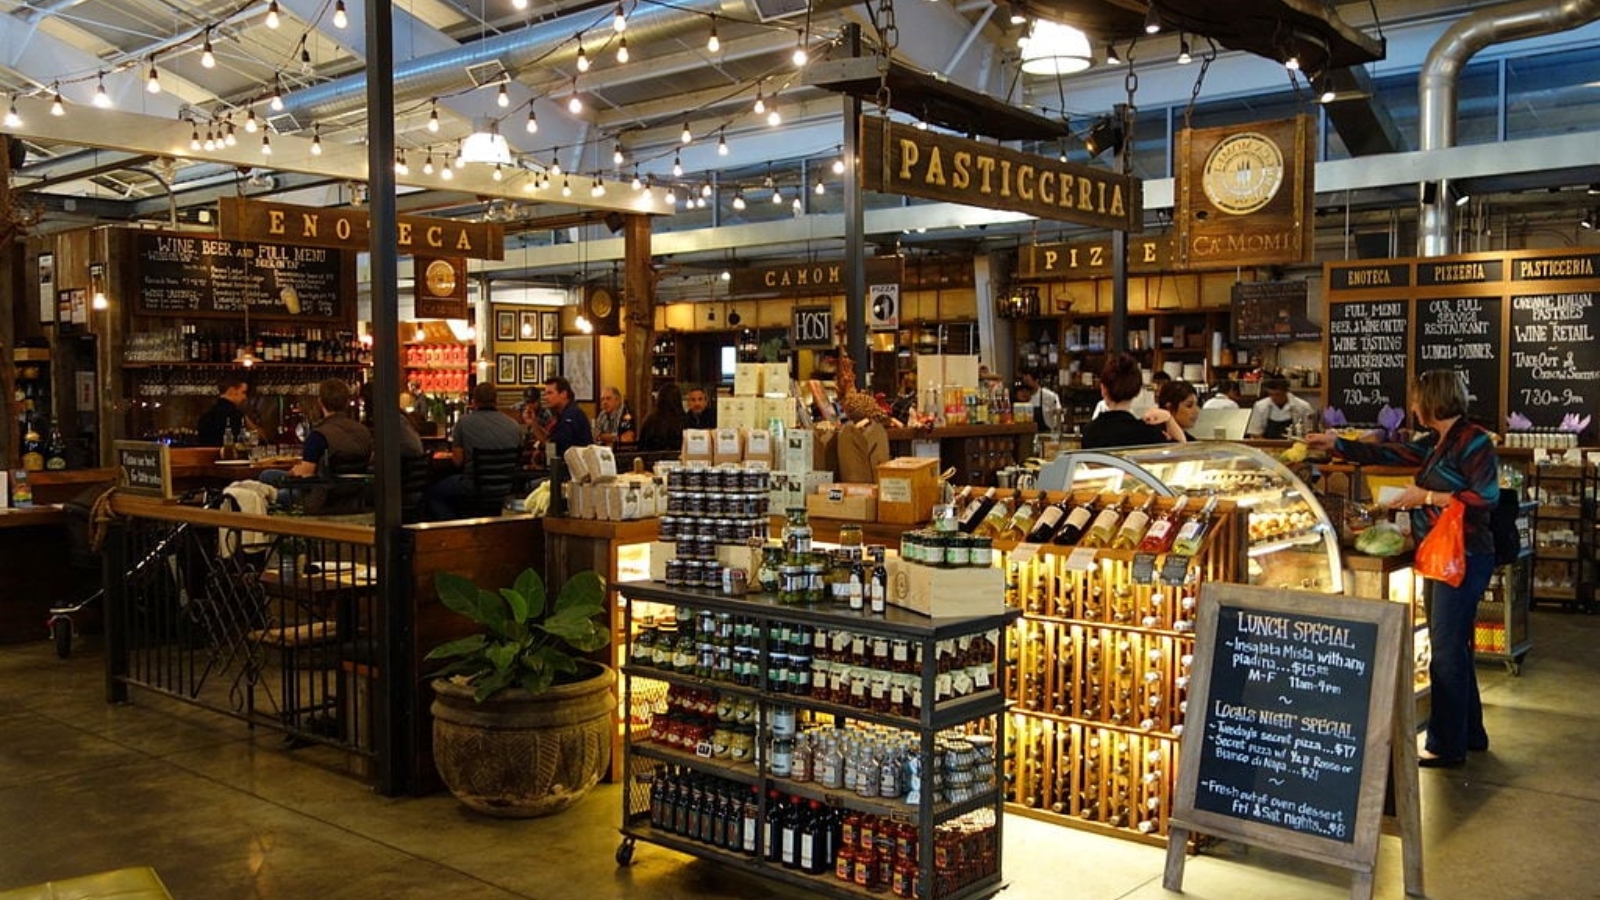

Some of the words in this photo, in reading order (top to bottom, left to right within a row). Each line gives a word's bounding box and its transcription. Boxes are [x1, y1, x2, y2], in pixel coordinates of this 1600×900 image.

[900, 138, 1127, 218] PASTICCERIA
[269, 210, 471, 250] ENOECA
[202, 240, 233, 256] BEER
[258, 245, 289, 260] FULL
[294, 247, 326, 262] MENU
[1045, 243, 1174, 270] PIZE
[765, 266, 840, 287] CAMOM
[1435, 263, 1485, 281] PIZZERIA
[1521, 258, 1593, 278] PASTICCERIA
[1348, 269, 1391, 286] ENOTECA
[1345, 304, 1368, 318] FULL
[1372, 303, 1401, 317] MENU
[1429, 300, 1452, 313] OUR
[1457, 299, 1482, 312] FULL
[1532, 306, 1583, 321] PASTRIES
[795, 311, 832, 341] HOST
[1425, 321, 1490, 335] RESTAURANT
[1514, 325, 1548, 342] WINE
[1552, 324, 1594, 342] RETAIL
[1332, 336, 1357, 351] WINE
[1360, 336, 1402, 351] TASTING
[1421, 344, 1452, 359] LUNCH
[1459, 343, 1495, 359] DINNER
[1353, 371, 1380, 385] OPEN
[1237, 611, 1291, 640] LUNCH
[1293, 621, 1355, 649] SPECIAL
[1283, 645, 1314, 661] Mista
[1248, 668, 1277, 683] M-F
[1300, 717, 1356, 741] SPECIAL
[1260, 732, 1293, 744] secret
[1248, 743, 1272, 756] pizza
[1232, 799, 1249, 814] Fri
[1270, 798, 1296, 811] oven
[1298, 802, 1343, 822] dessert
